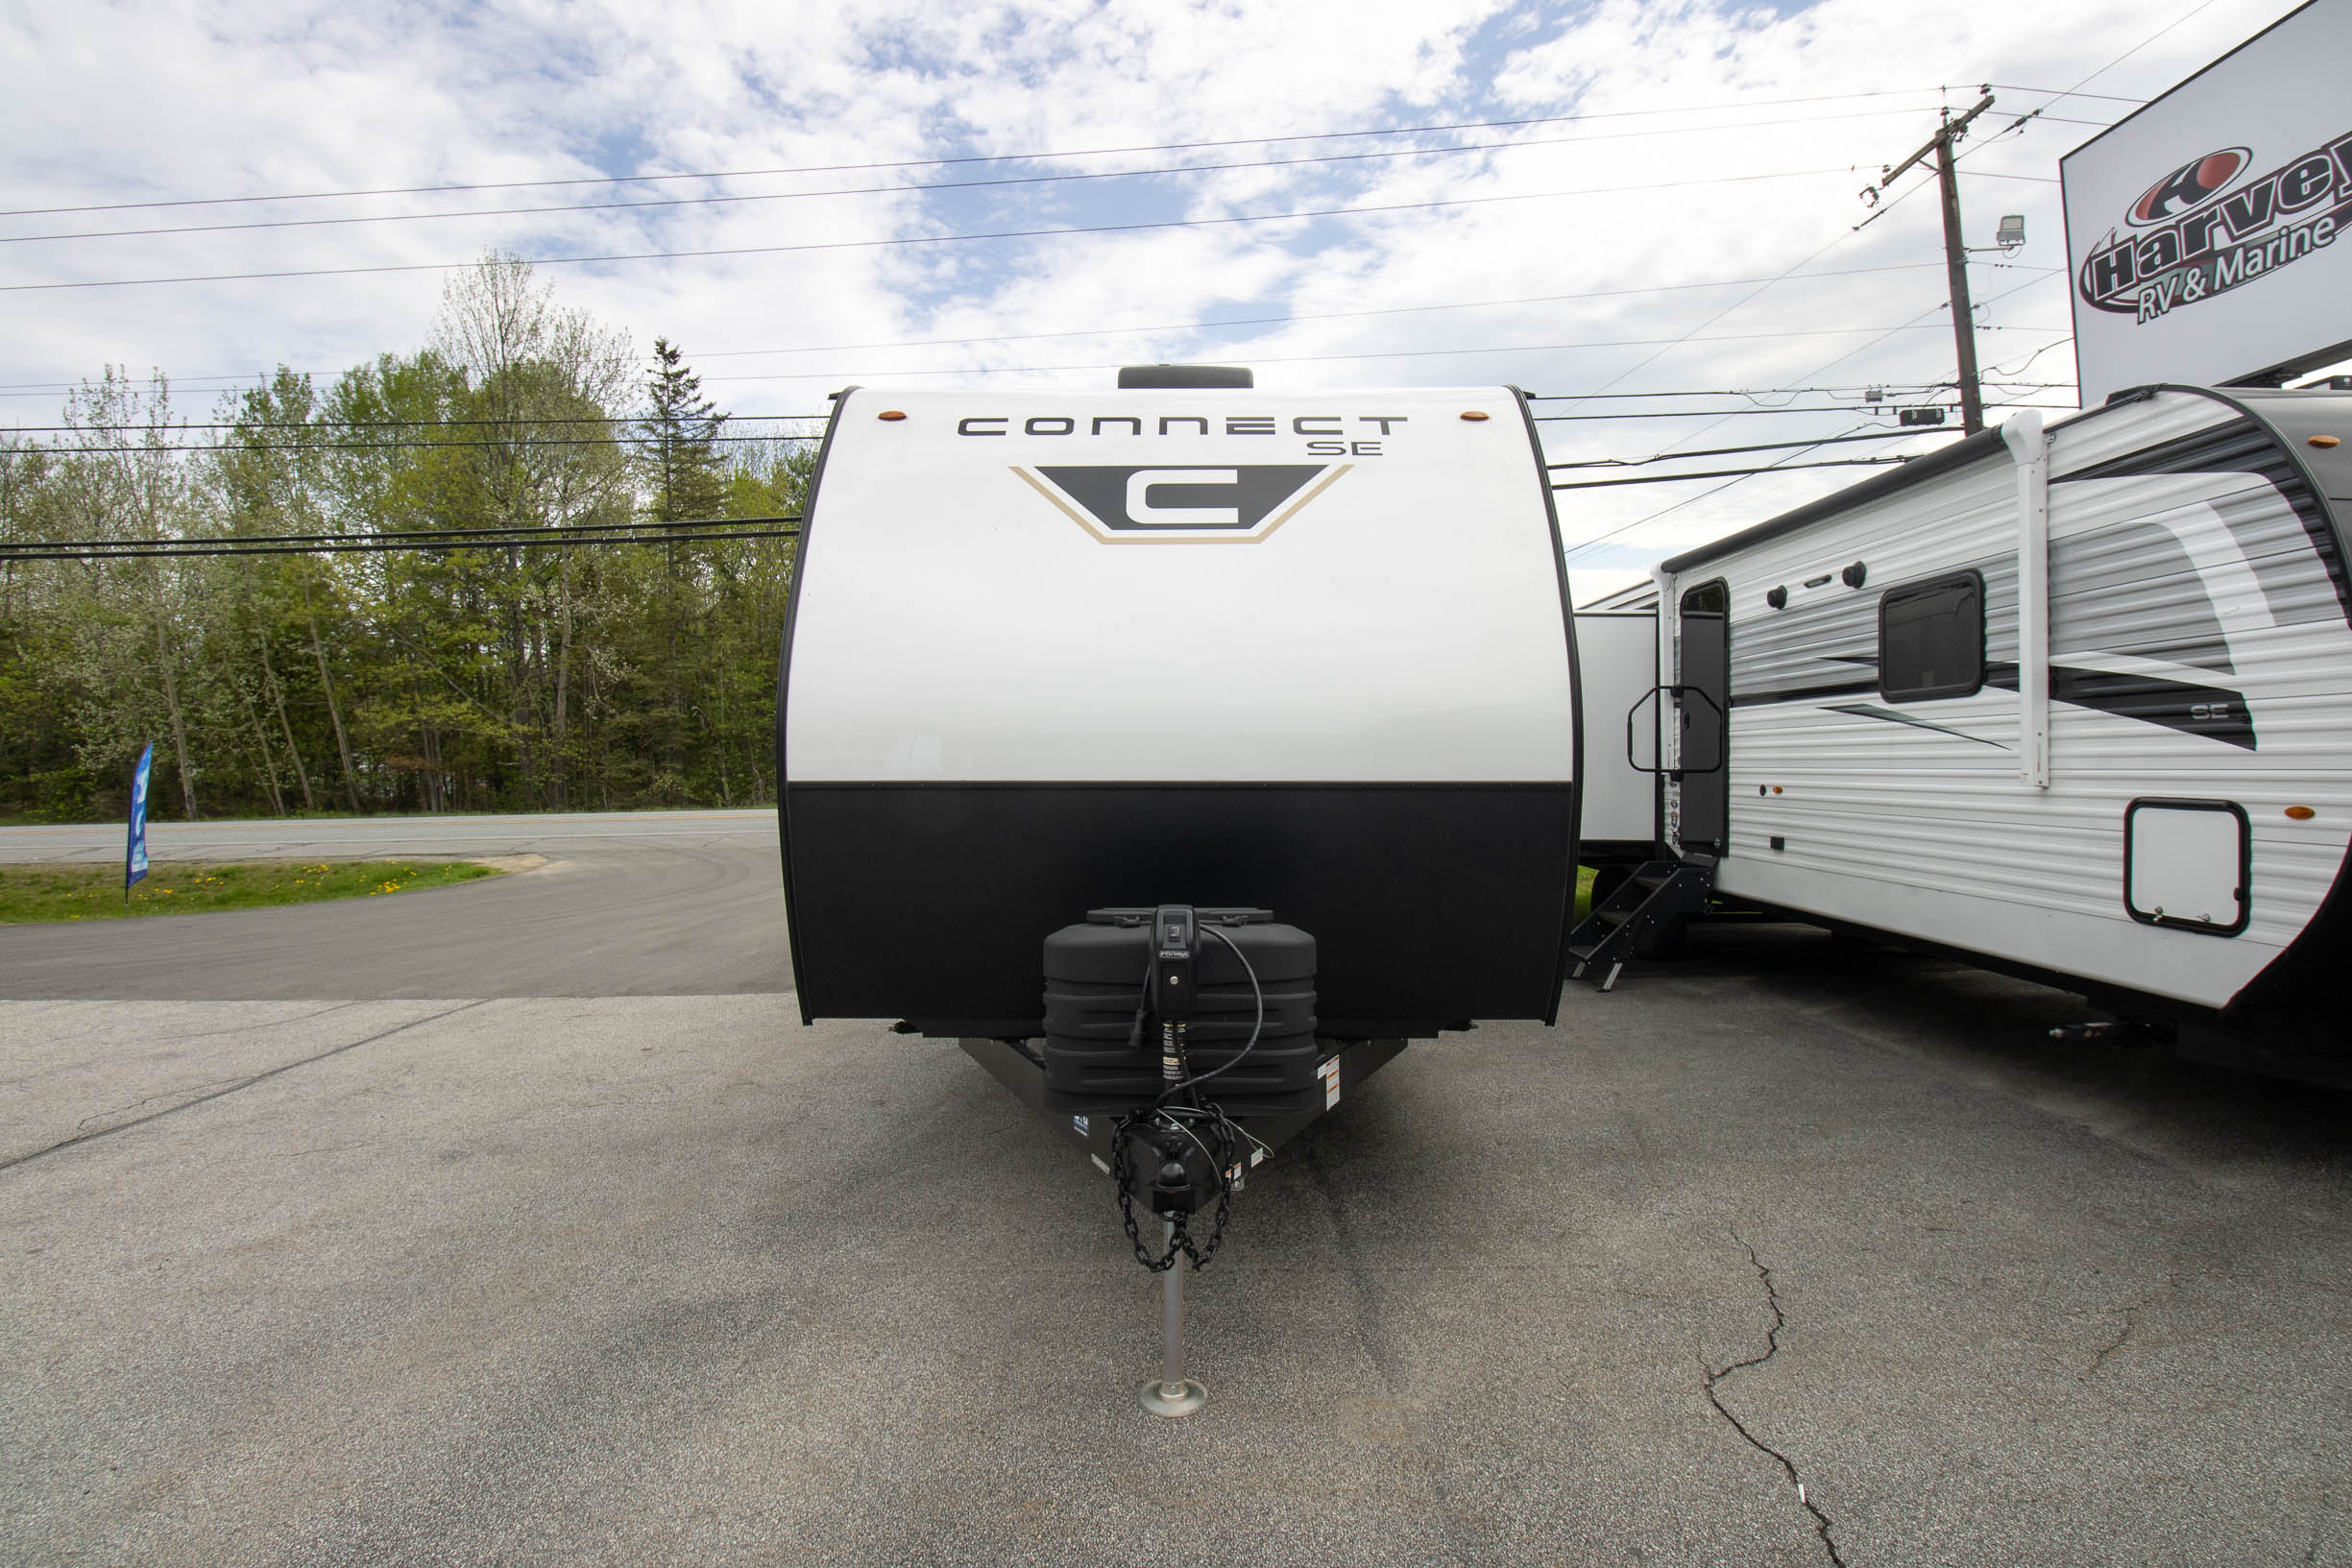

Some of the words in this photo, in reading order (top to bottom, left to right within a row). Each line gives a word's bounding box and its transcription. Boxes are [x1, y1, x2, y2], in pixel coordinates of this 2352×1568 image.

[2137, 275, 2179, 325] RV
[2181, 266, 2208, 303] &
[2213, 214, 2337, 291] Marine
[958, 417, 1408, 436] CONNECT
[1306, 441, 1384, 456] SE
[2190, 703, 2229, 719] SE
